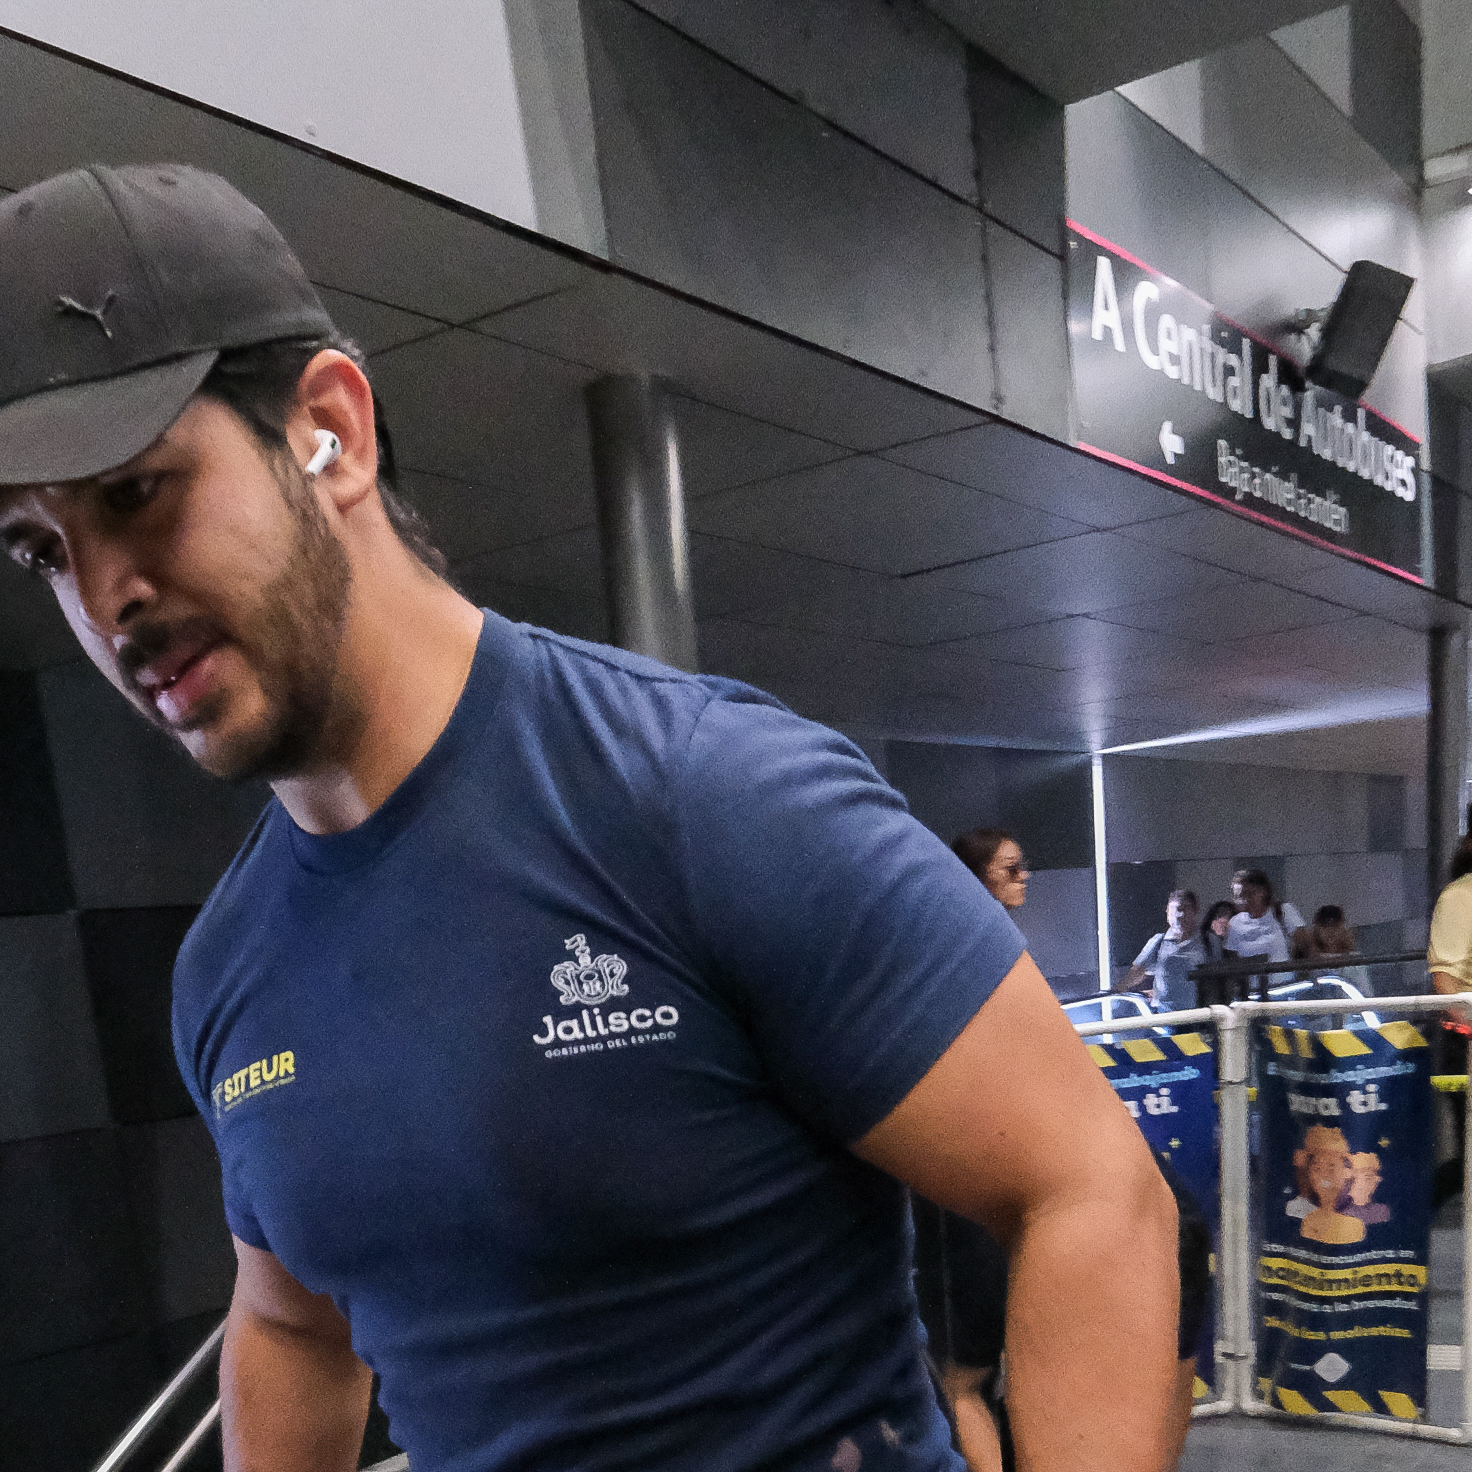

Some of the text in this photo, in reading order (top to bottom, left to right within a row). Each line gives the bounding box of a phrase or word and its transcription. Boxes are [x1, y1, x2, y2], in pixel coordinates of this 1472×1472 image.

[1091, 255, 1126, 352] A
[1133, 281, 1254, 418] Central
[1259, 354, 1294, 439] de
[533, 1005, 679, 1045] Jalisco
[545, 1031, 677, 1059] GOBIERNO DEL ESTADO
[224, 1050, 295, 1103] SITEUR
